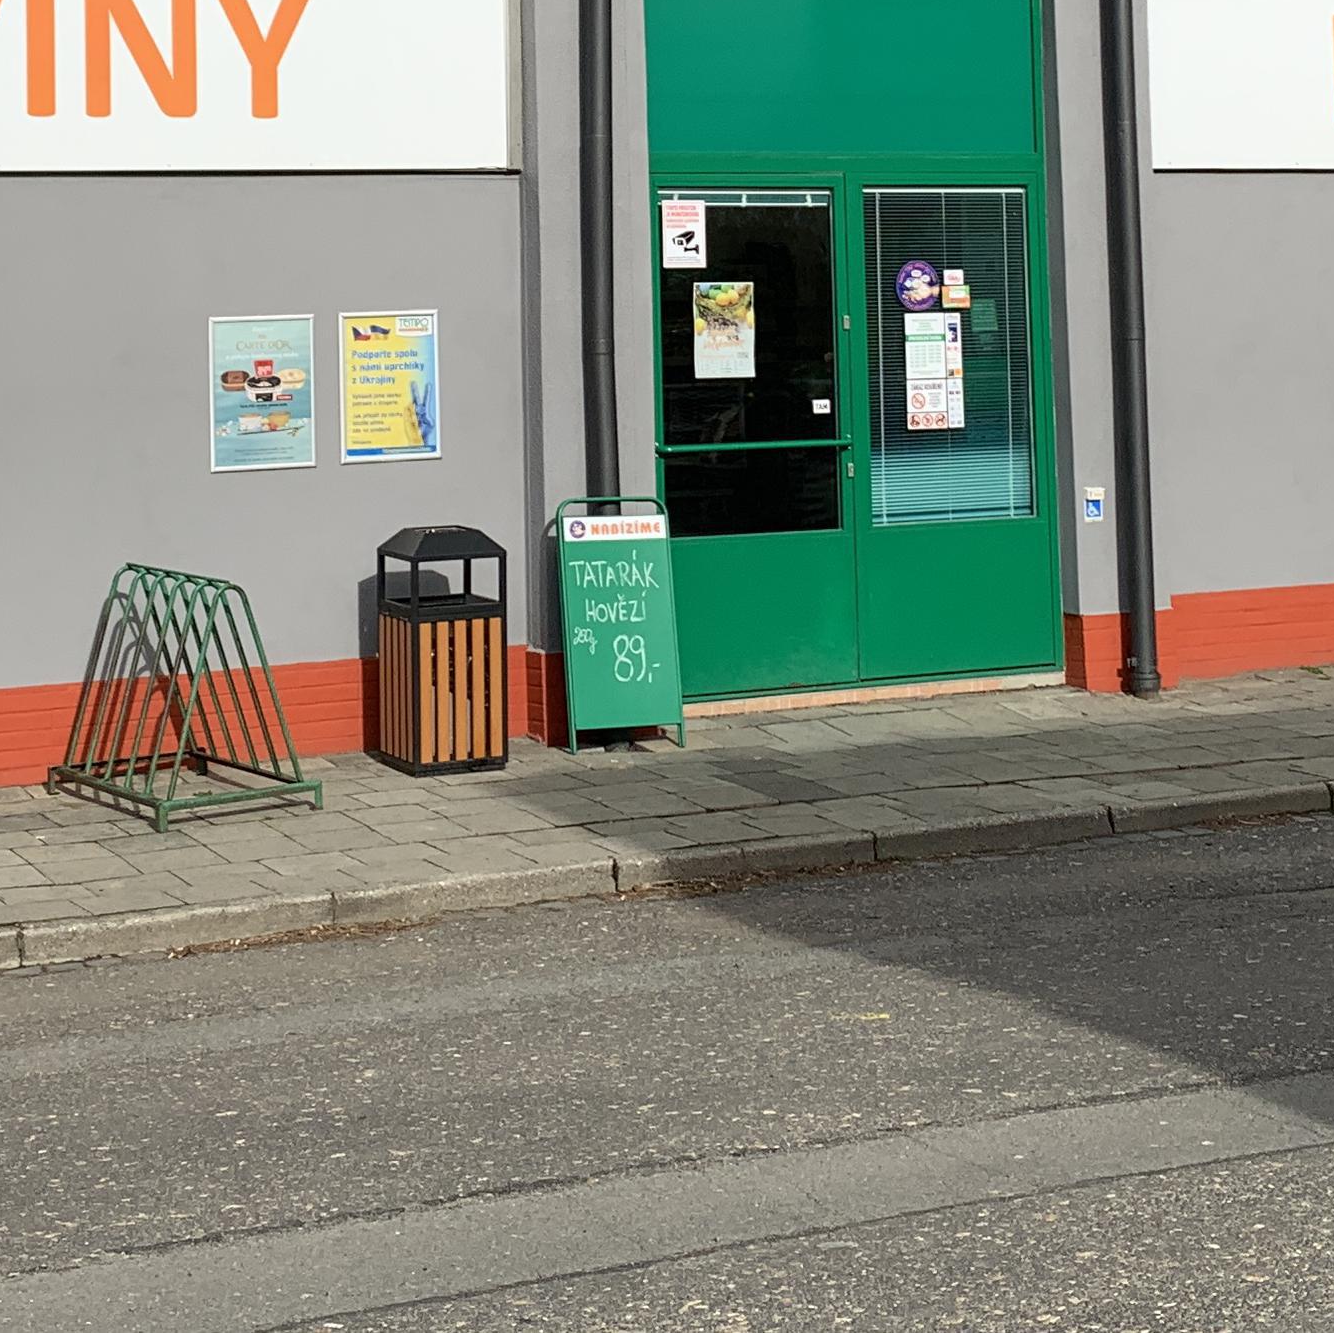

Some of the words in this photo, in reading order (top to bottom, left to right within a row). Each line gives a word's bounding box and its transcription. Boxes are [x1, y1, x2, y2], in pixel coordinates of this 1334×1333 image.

[395, 349, 418, 359] spolu
[590, 520, 661, 536] NABÍZÍME
[569, 549, 660, 589] TATARÁK
[585, 589, 647, 624] HOVĚZÍ
